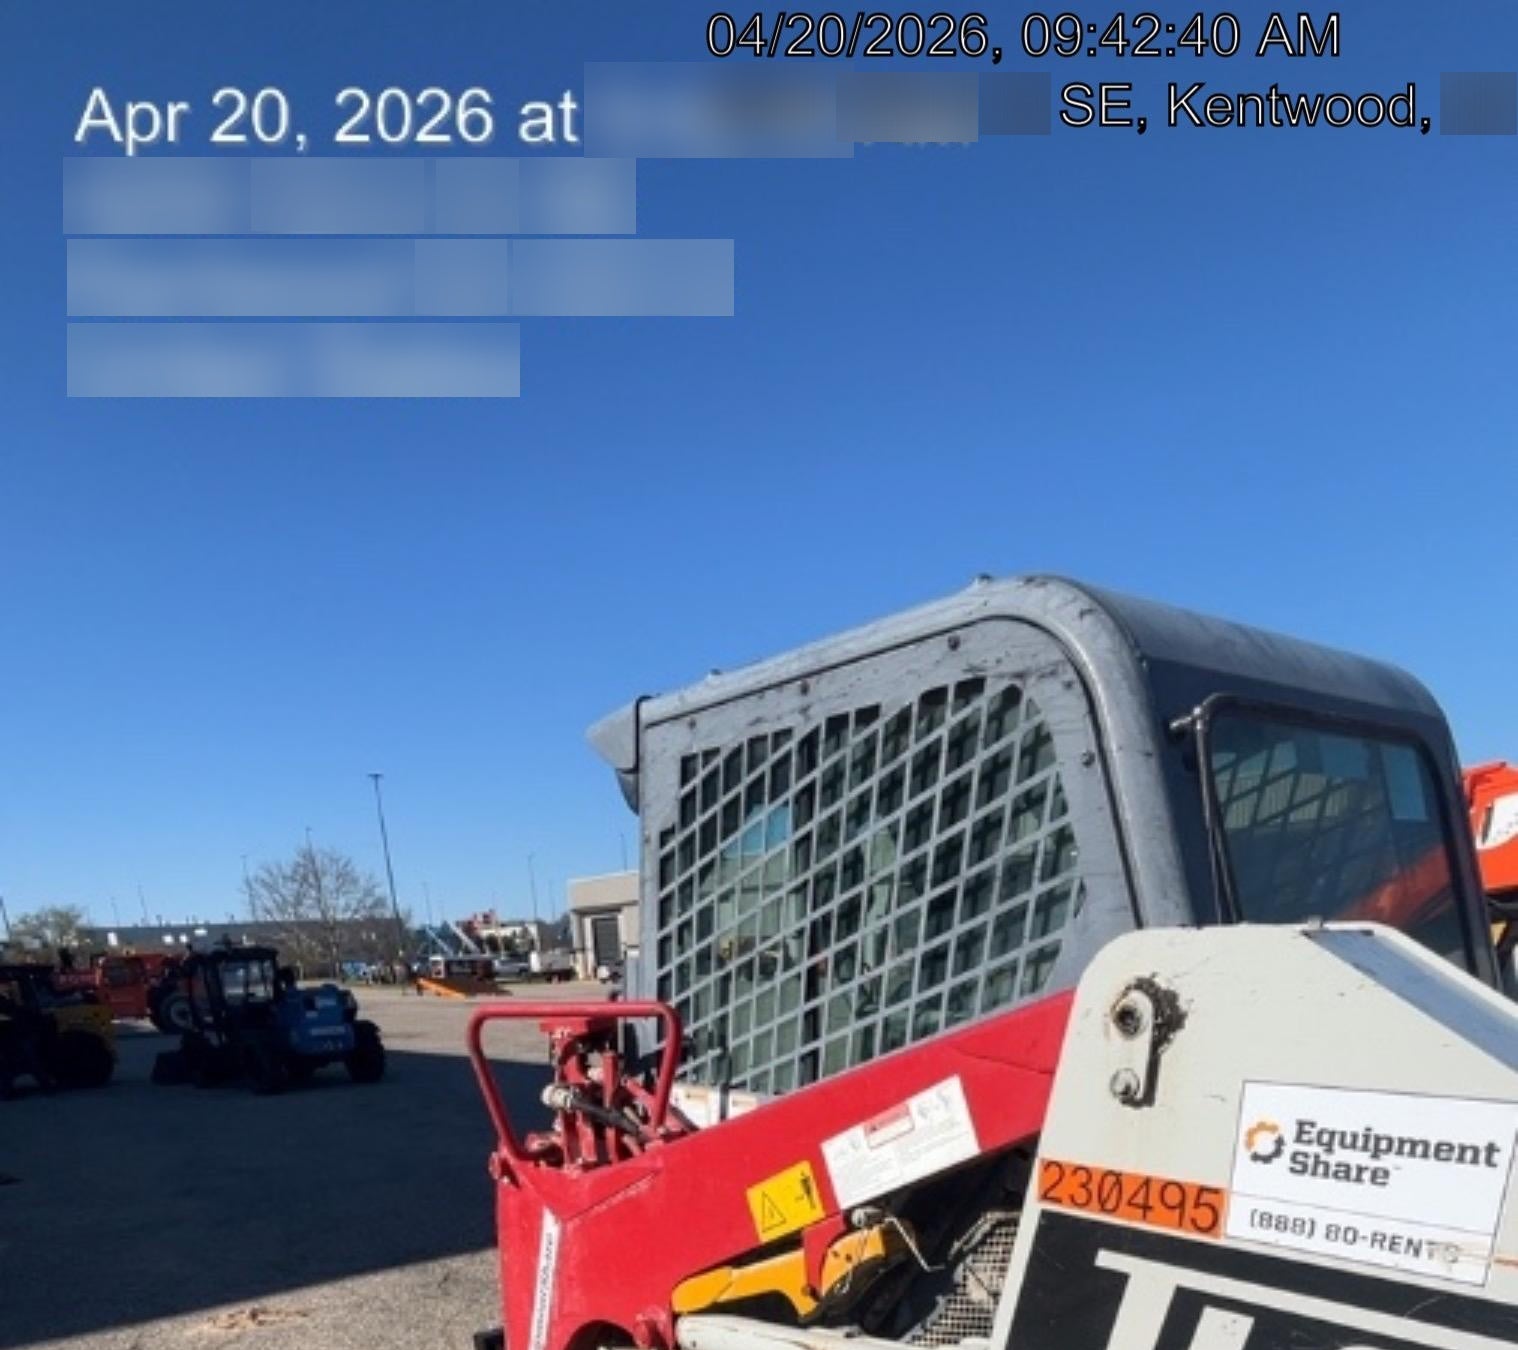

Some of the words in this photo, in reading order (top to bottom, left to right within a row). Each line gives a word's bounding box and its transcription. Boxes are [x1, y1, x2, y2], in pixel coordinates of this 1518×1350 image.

[1293, 1119, 1500, 1168] Equipment
[1289, 1151, 1390, 1186] Share
[1041, 1160, 1221, 1234] 230495
[1250, 1209, 1317, 1238] (888)
